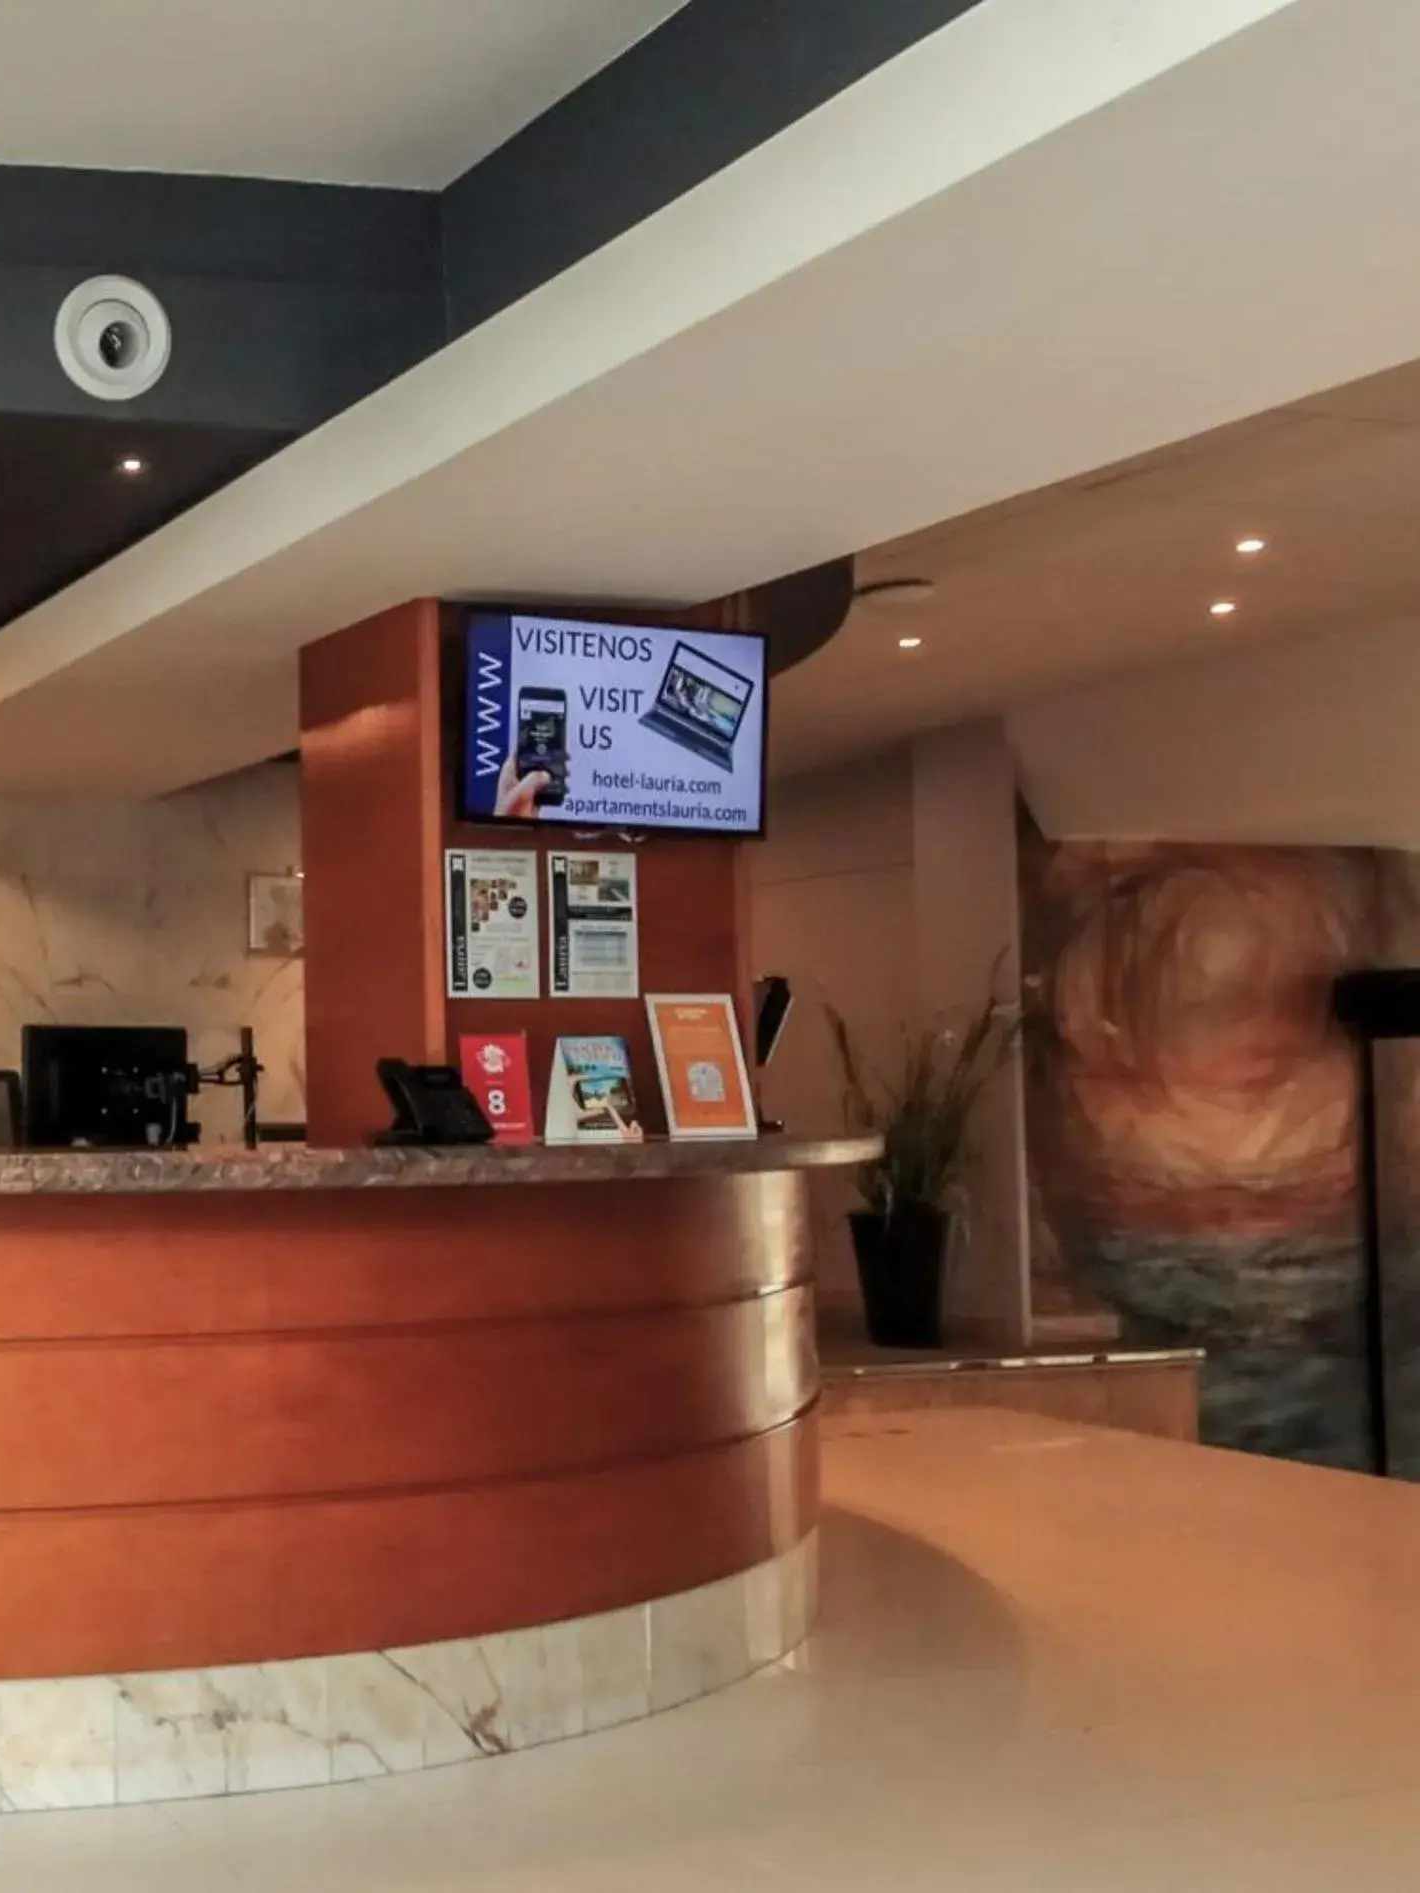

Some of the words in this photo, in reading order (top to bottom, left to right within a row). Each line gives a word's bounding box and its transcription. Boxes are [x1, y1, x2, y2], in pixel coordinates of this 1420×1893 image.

[516, 626, 653, 663] VISITENOS
[579, 685, 644, 715] VISIT
[579, 723, 613, 751] US
[592, 769, 722, 795] hotel-lauria.com
[565, 798, 747, 822] apartamentslauria.com
[488, 1089, 506, 1115] 8
